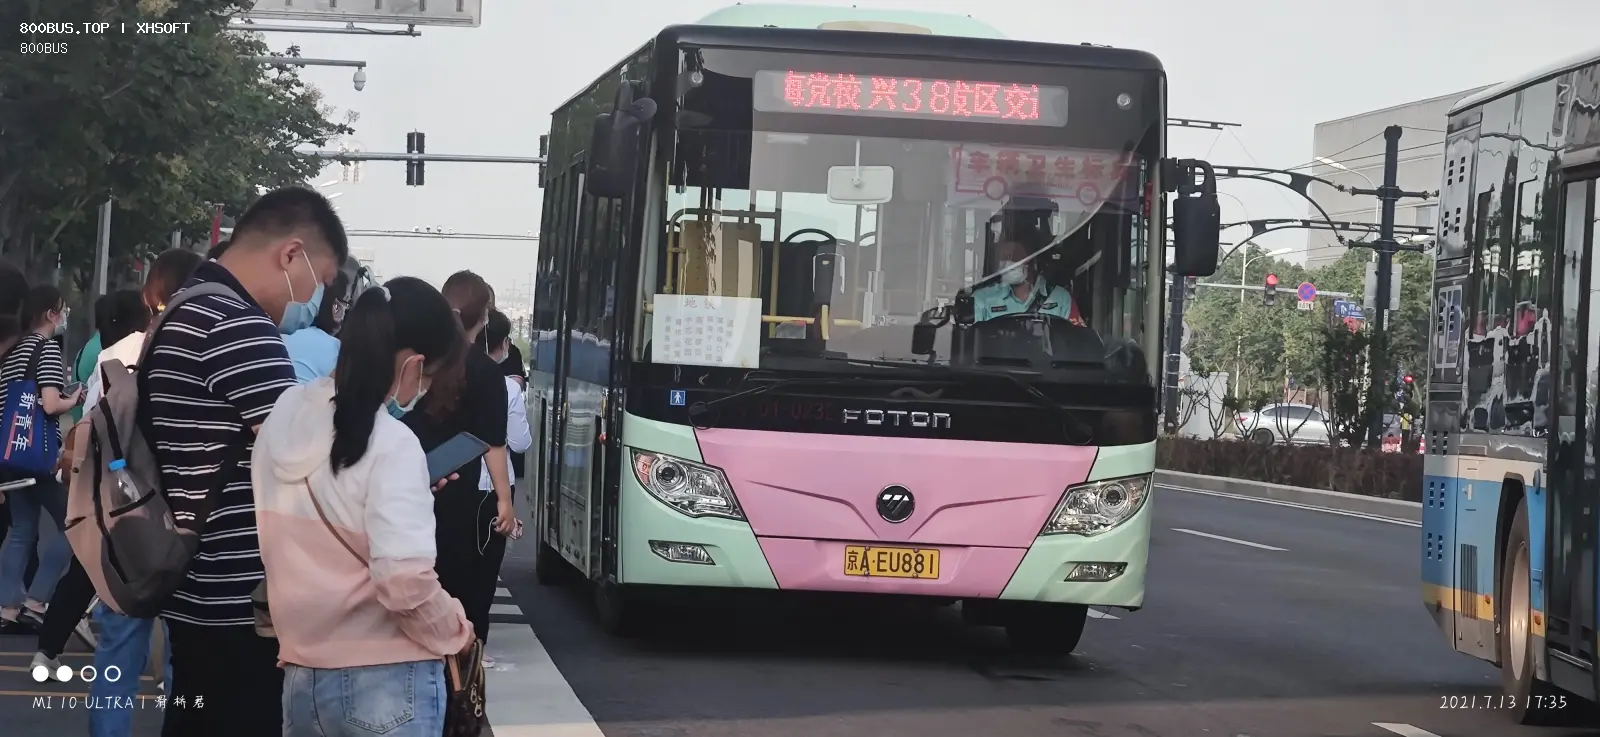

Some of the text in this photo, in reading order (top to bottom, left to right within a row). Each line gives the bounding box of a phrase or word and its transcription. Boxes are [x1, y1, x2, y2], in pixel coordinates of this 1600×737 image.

[11, 391, 36, 452] 新青年
[843, 408, 952, 428] FOTON
